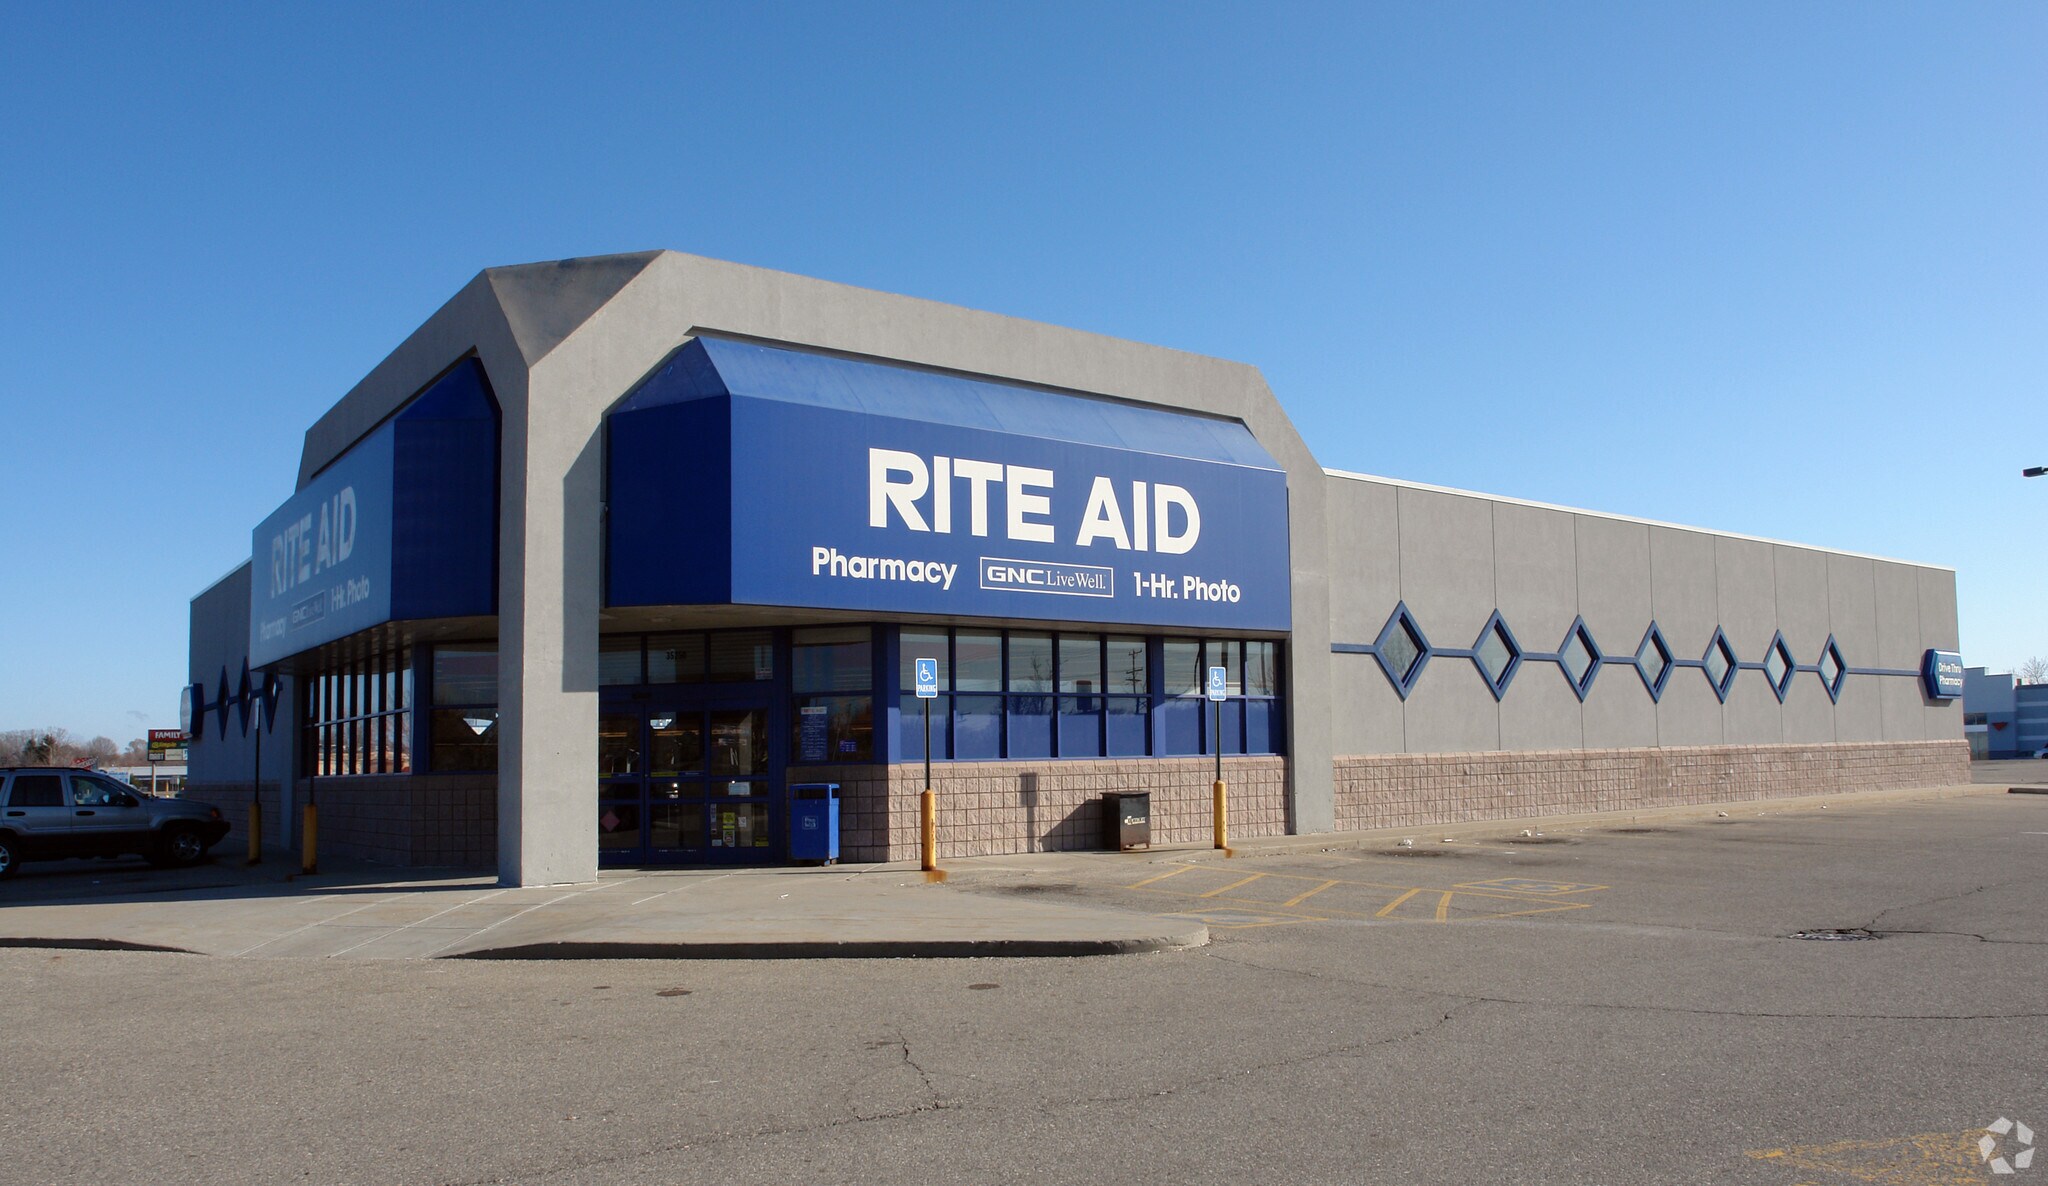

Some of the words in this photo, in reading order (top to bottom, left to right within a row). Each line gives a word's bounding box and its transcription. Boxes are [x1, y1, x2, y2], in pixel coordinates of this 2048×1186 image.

[868, 447, 1055, 543] RITE
[1075, 476, 1201, 555] AID
[271, 513, 312, 598] RITE
[315, 486, 357, 575] AID
[812, 546, 958, 590] Pharmacy
[987, 565, 1044, 585] GNC
[347, 576, 370, 606] Photo
[1133, 571, 1179, 599] 1-Hr.
[1183, 575, 1241, 603] Photo
[1939, 674, 1963, 687] Pharmacy
[155, 731, 181, 739] FAMILY
